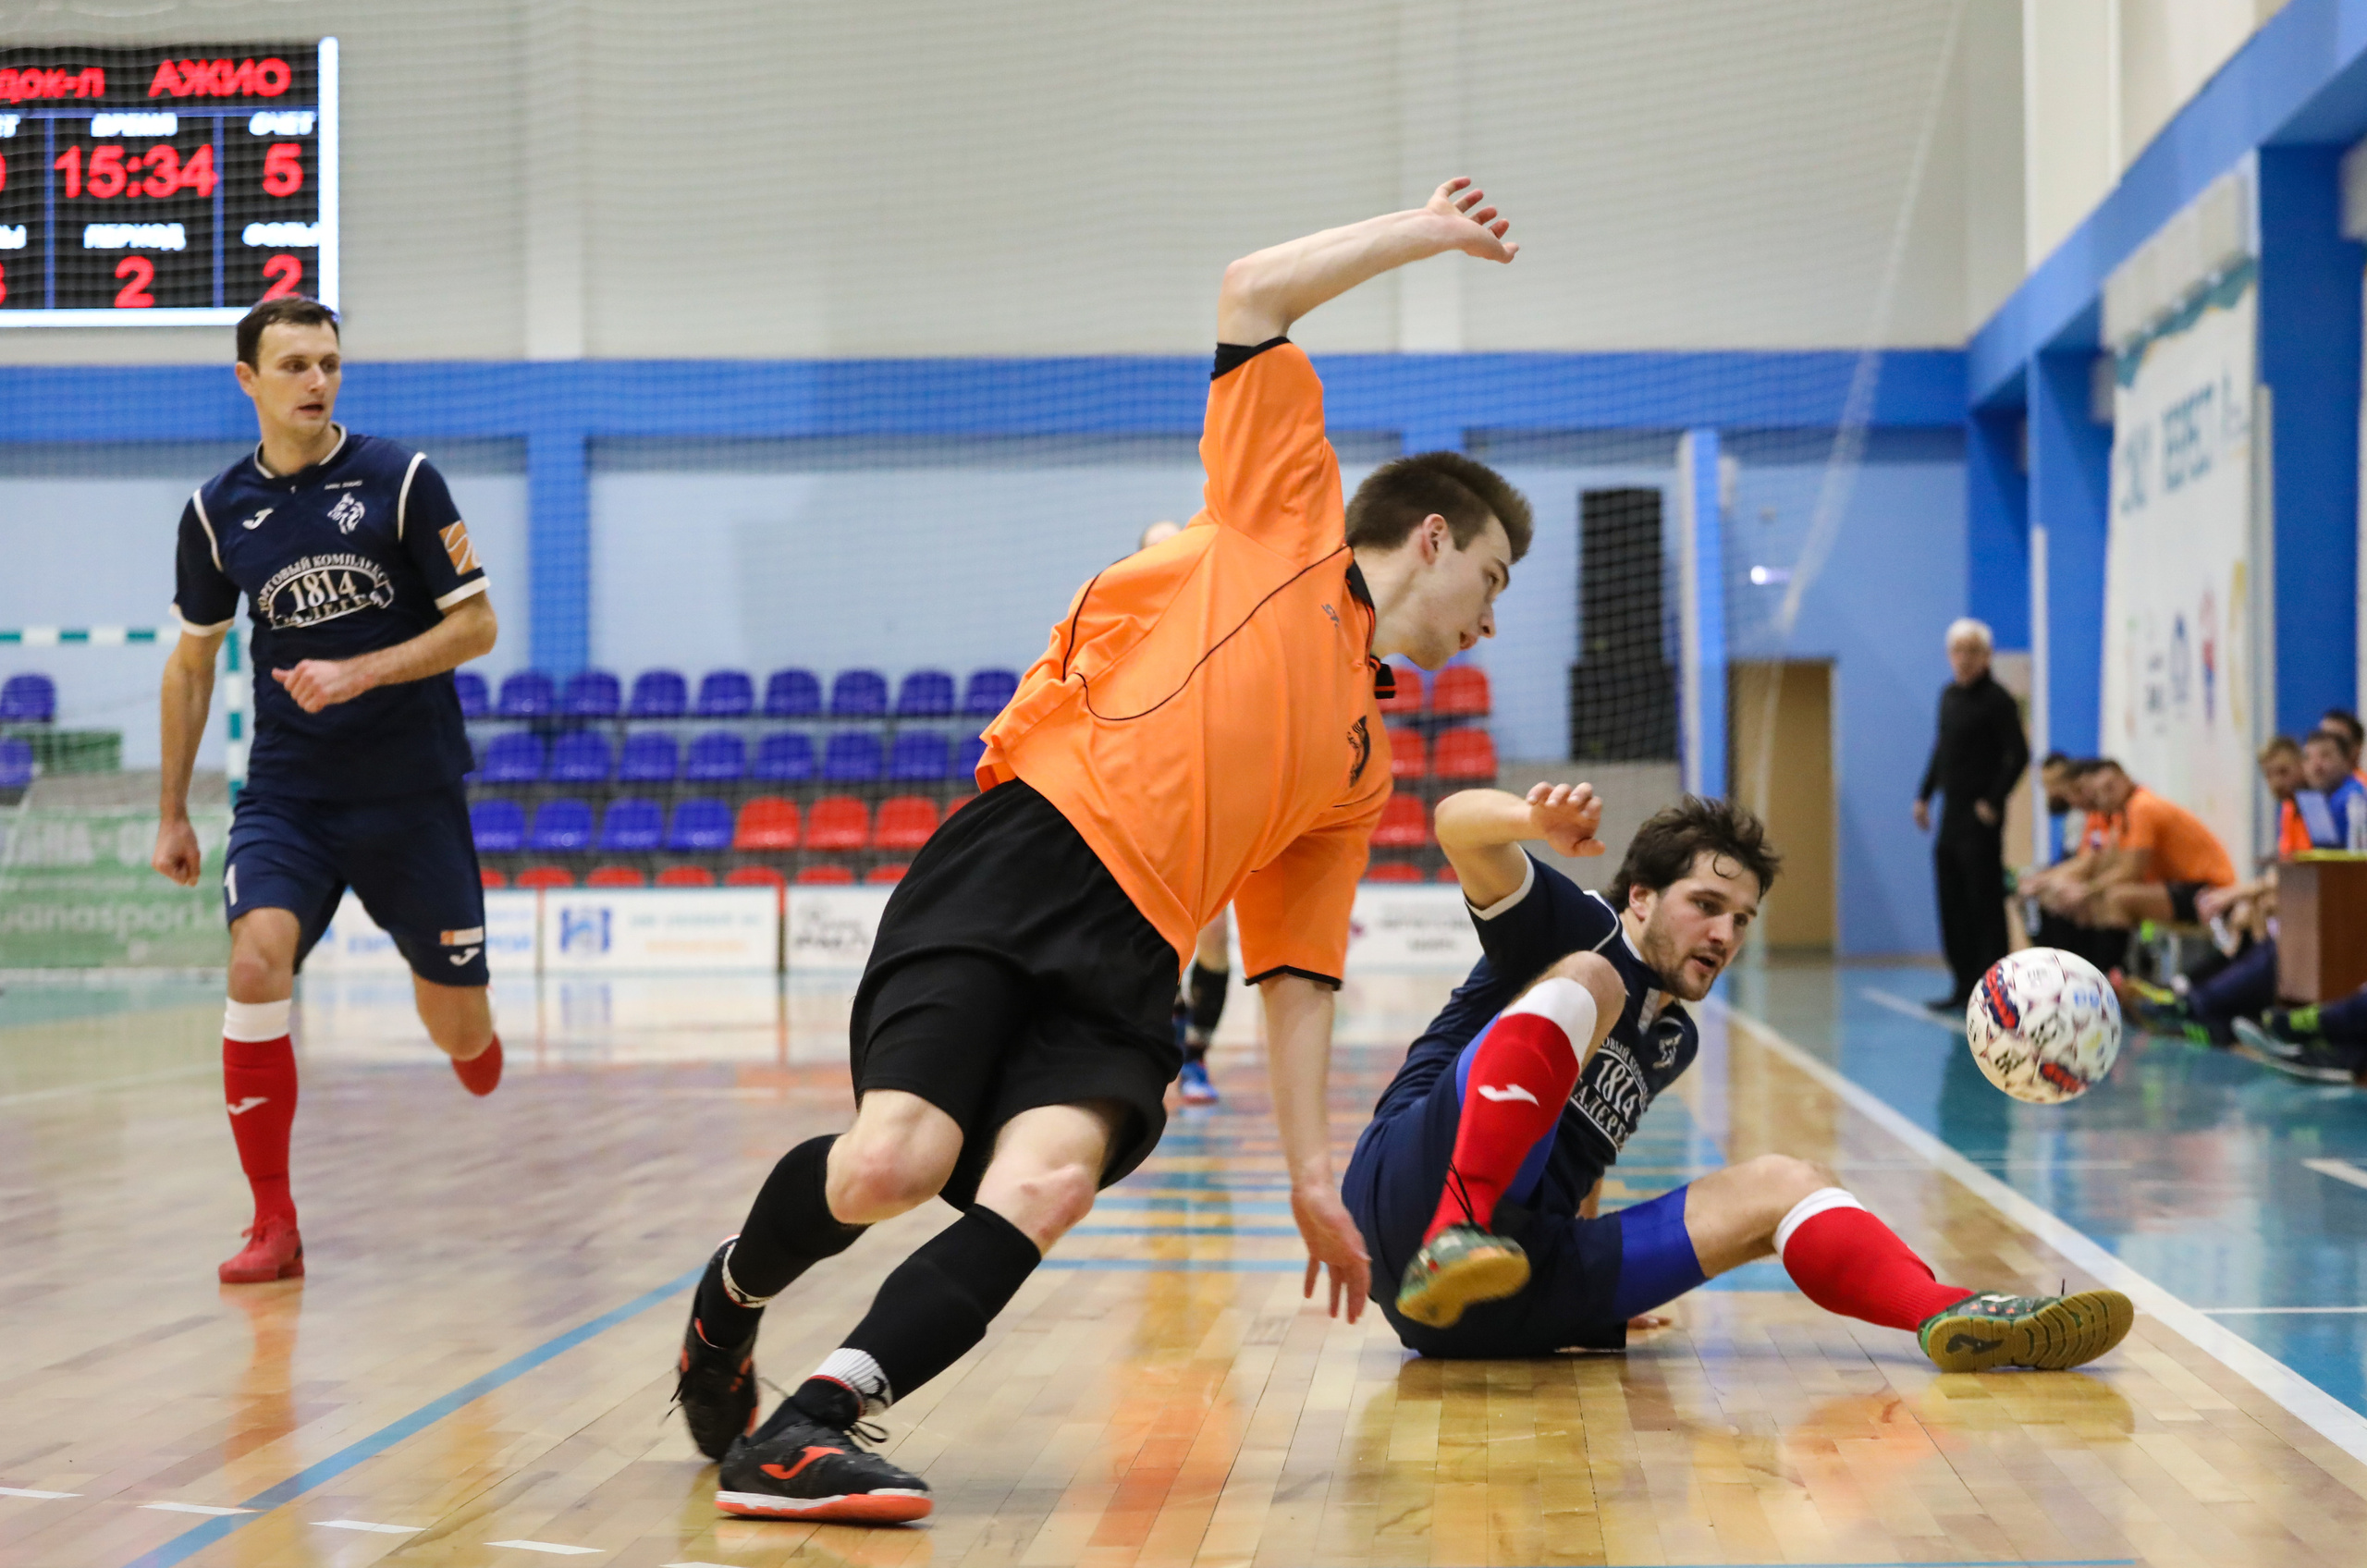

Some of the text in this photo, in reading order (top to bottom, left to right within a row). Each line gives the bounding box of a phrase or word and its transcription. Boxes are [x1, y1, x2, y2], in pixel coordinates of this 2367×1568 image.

[148, 57, 291, 97] АЖИО
[54, 144, 219, 198] 15:34
[263, 142, 304, 197] 5
[114, 255, 155, 308] 2
[262, 253, 303, 303] 2
[288, 570, 358, 612] 1814
[1593, 1059, 1639, 1121] 1814
